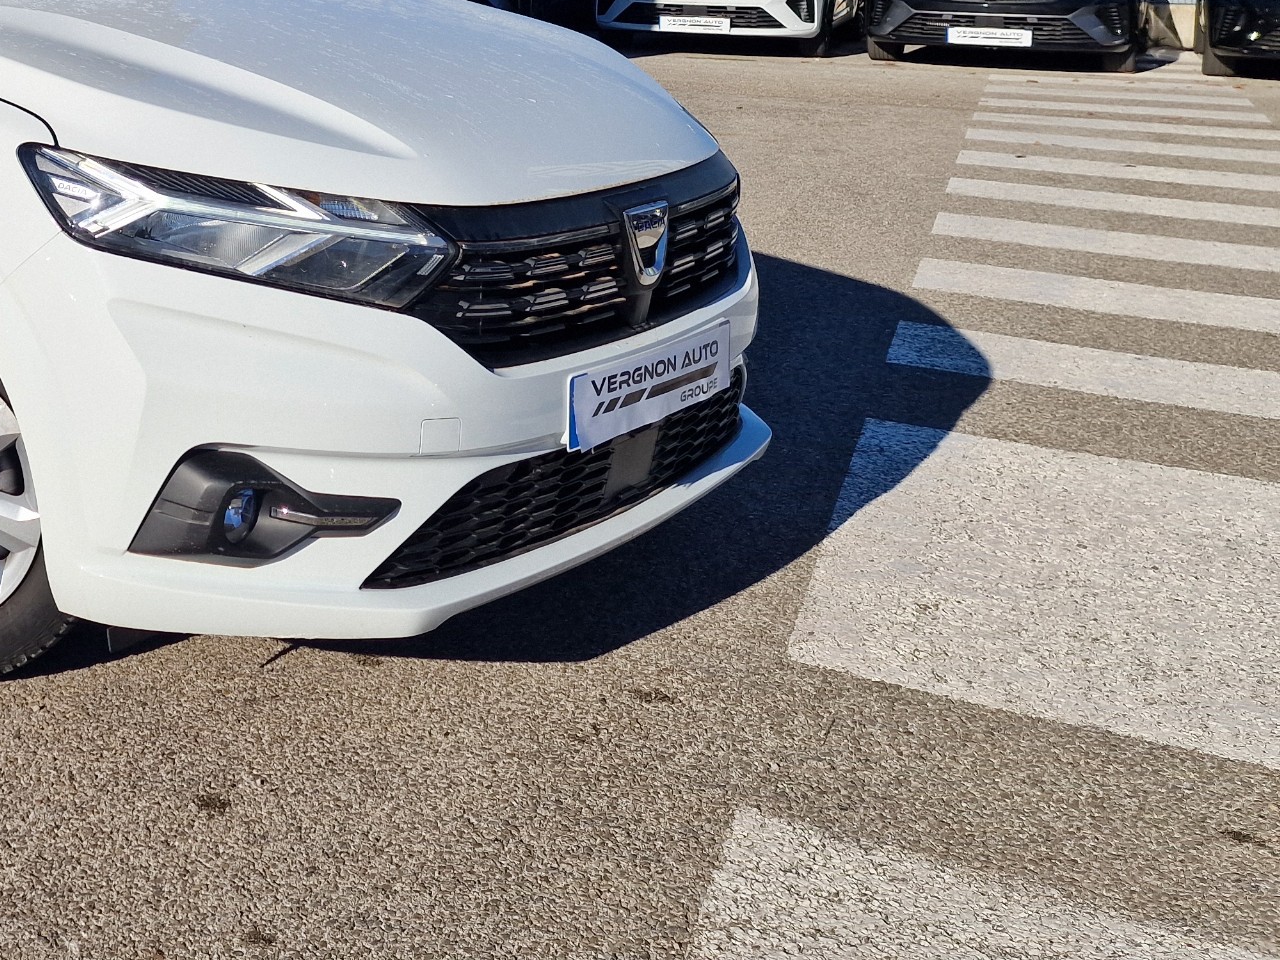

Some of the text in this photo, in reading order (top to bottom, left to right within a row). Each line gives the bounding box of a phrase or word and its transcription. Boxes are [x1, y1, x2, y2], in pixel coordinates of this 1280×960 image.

[590, 339, 719, 397] VERGNON AUTO
[680, 377, 718, 402] GROUPE
